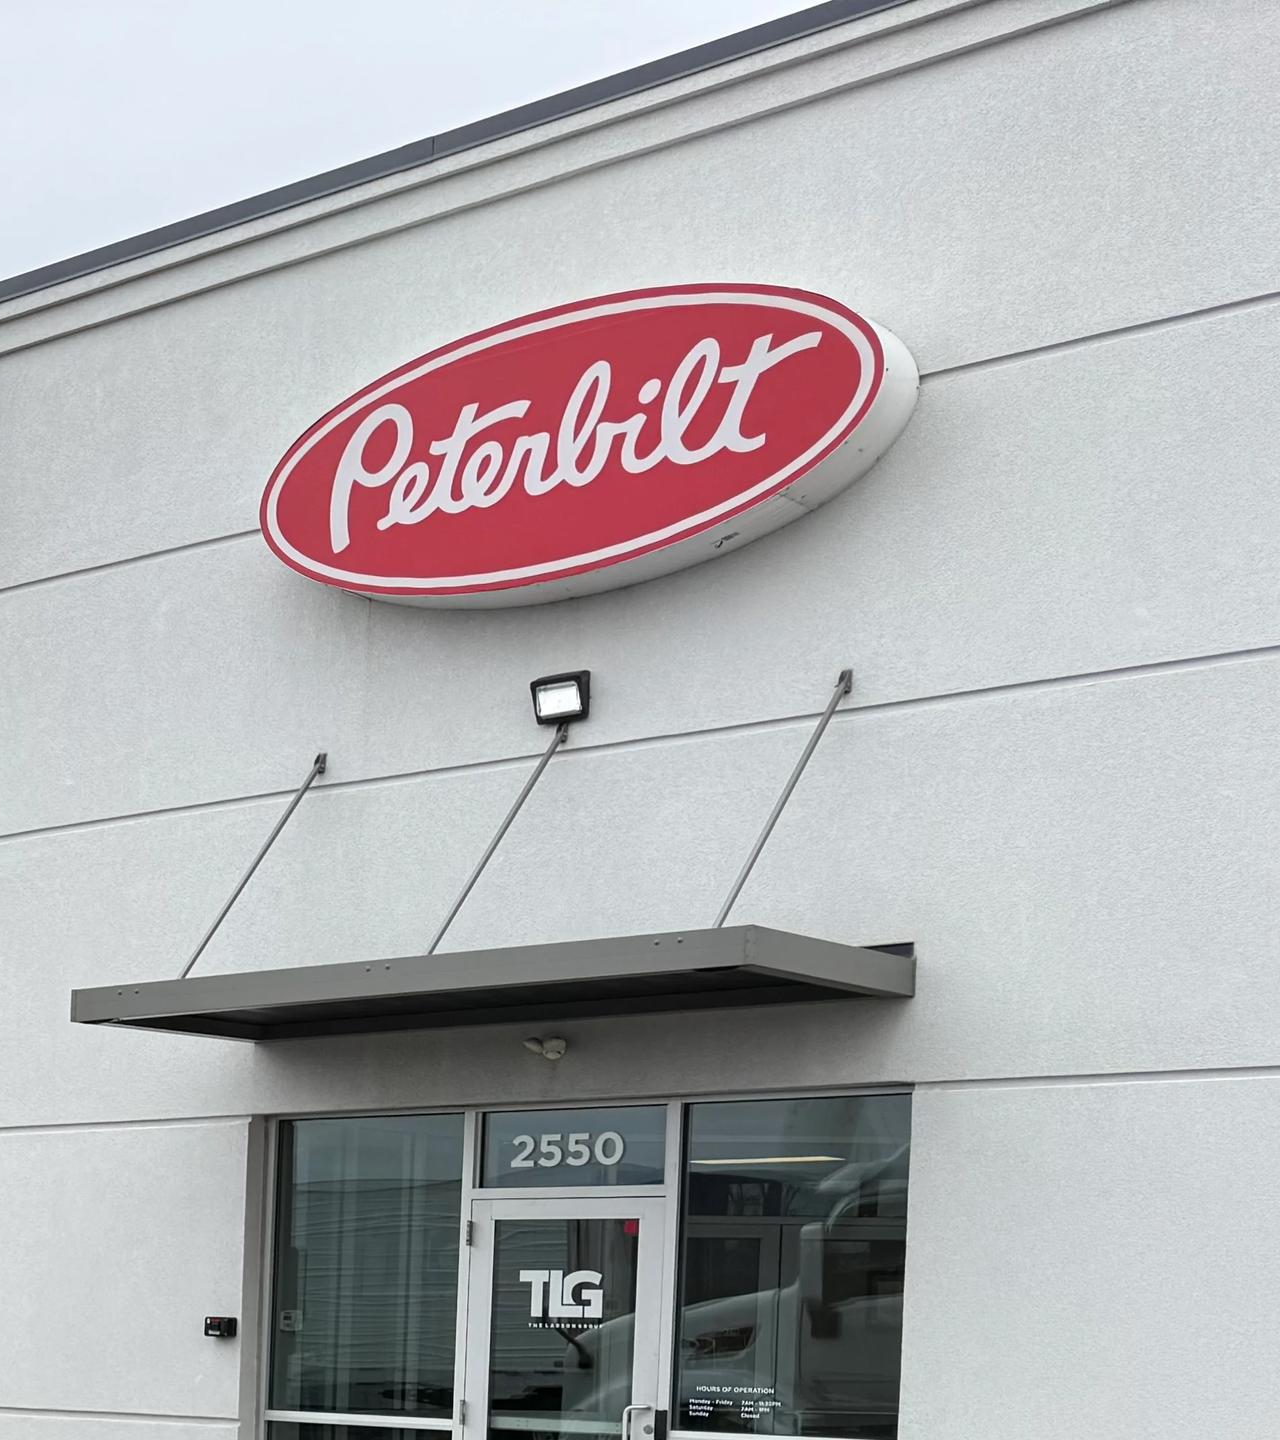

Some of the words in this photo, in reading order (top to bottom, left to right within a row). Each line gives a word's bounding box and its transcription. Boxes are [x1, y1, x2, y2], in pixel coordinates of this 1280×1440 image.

[330, 331, 822, 554] Peterbilt
[510, 1131, 625, 1169] 2550
[519, 1269, 604, 1319] TLG
[696, 1385, 721, 1393] HOURS
[733, 1387, 775, 1395] OPERATION
